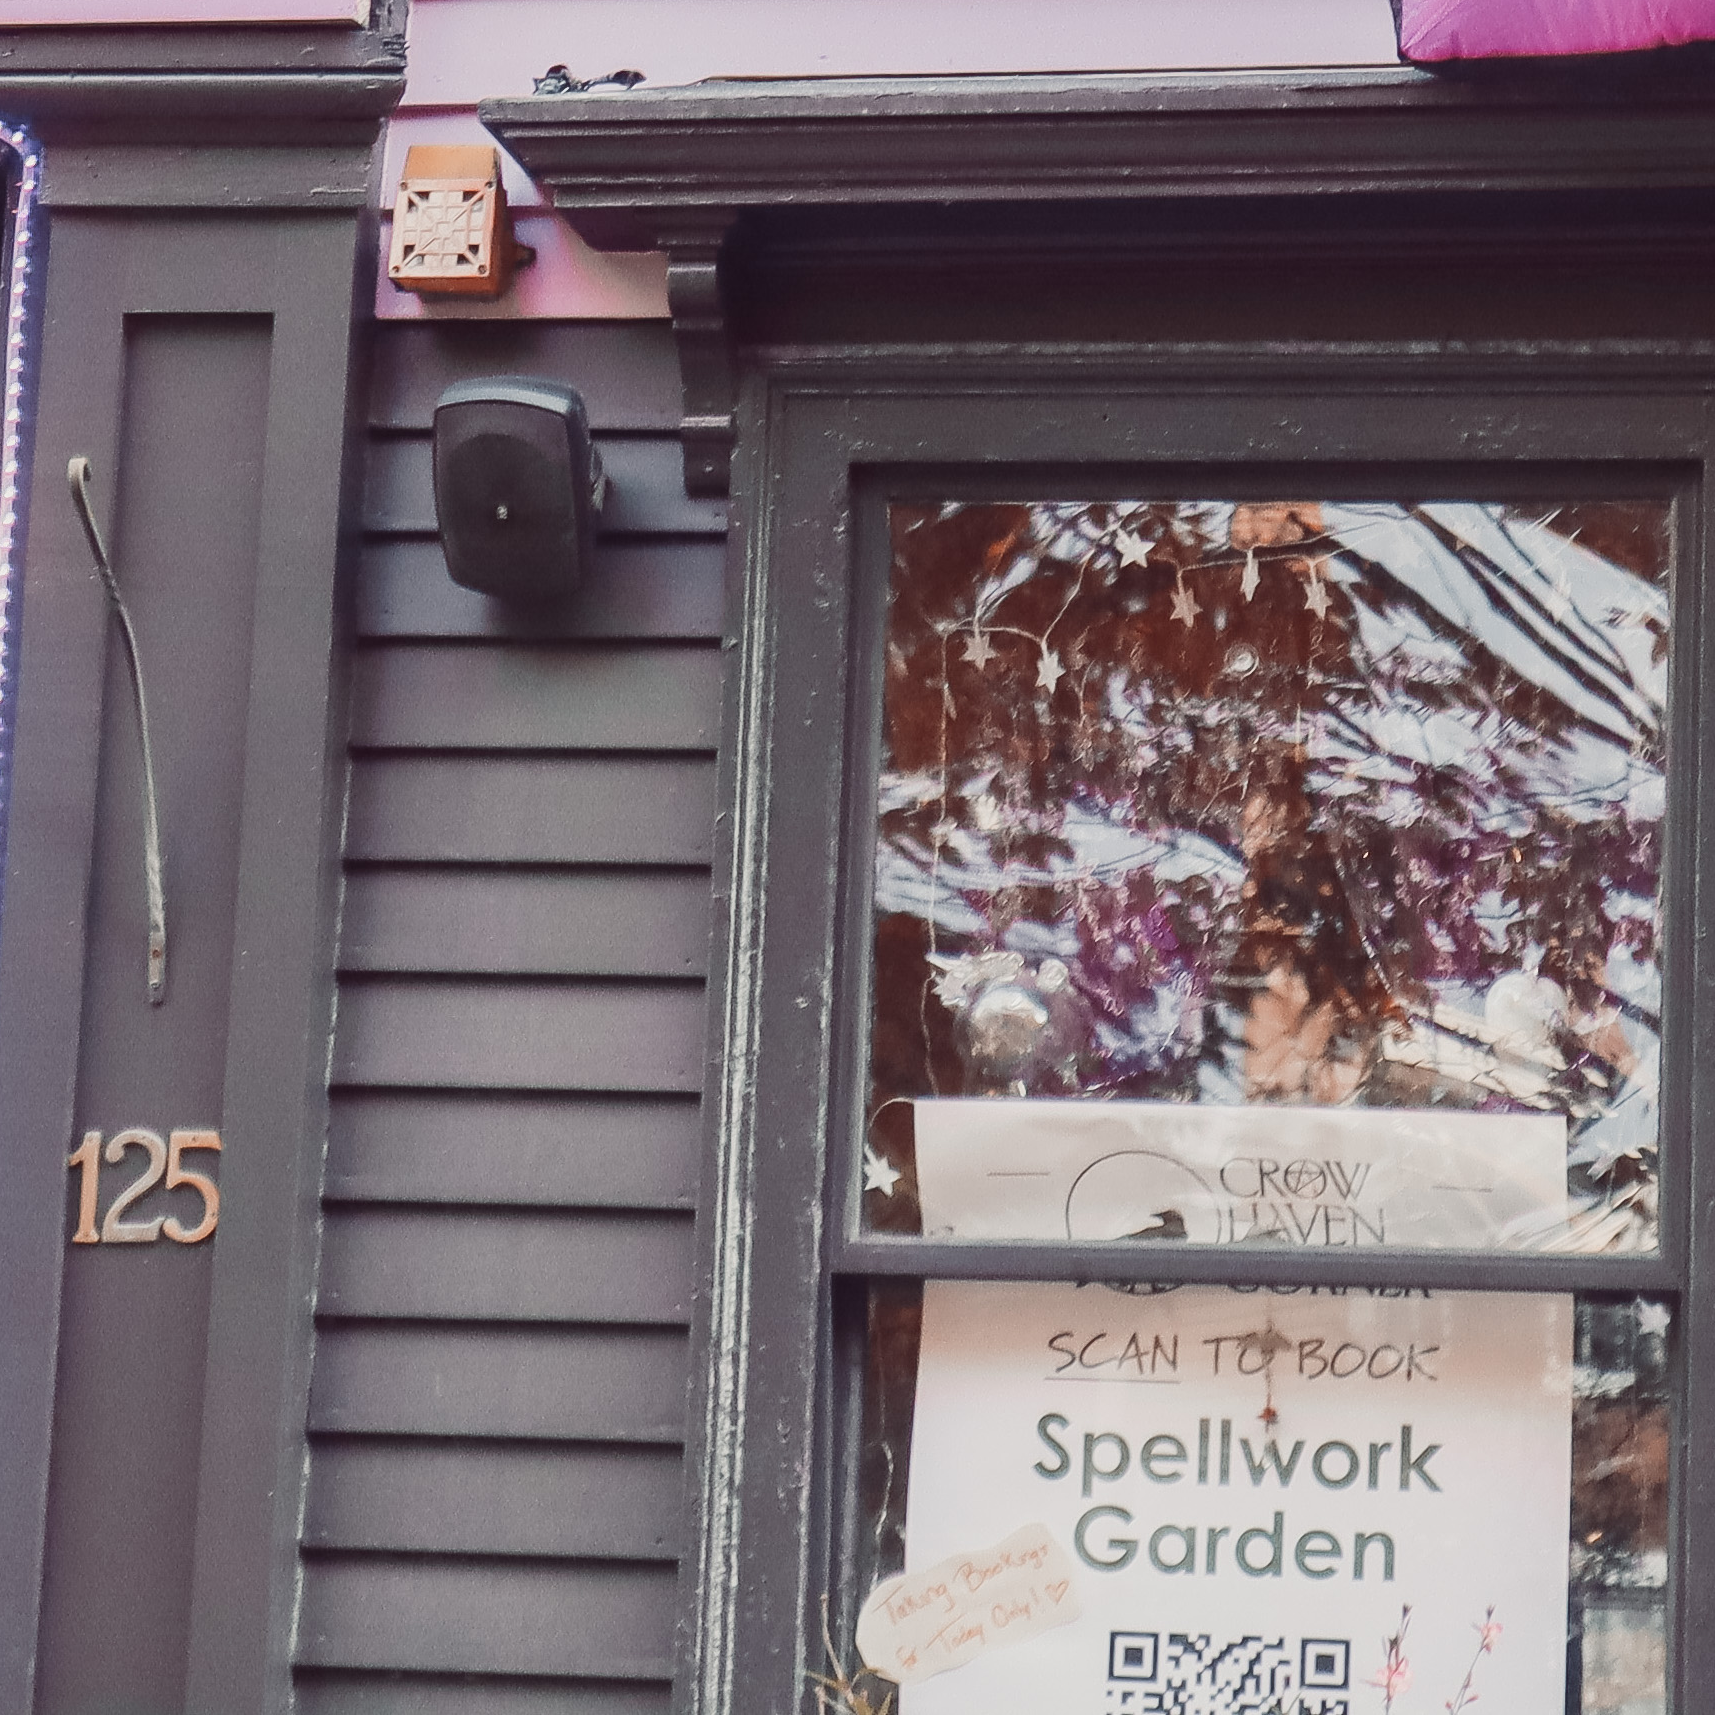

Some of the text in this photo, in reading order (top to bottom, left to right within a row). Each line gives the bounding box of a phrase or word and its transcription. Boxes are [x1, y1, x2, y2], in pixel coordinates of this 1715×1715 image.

[68, 1128, 223, 1244] 125
[1219, 1157, 1372, 1201] CROW
[1228, 1202, 1385, 1247] HAVEN
[1048, 1331, 1441, 1382] SCAN TO BOOK
[1033, 1412, 1444, 1499] Spellwork
[1073, 1504, 1396, 1582] Garden
